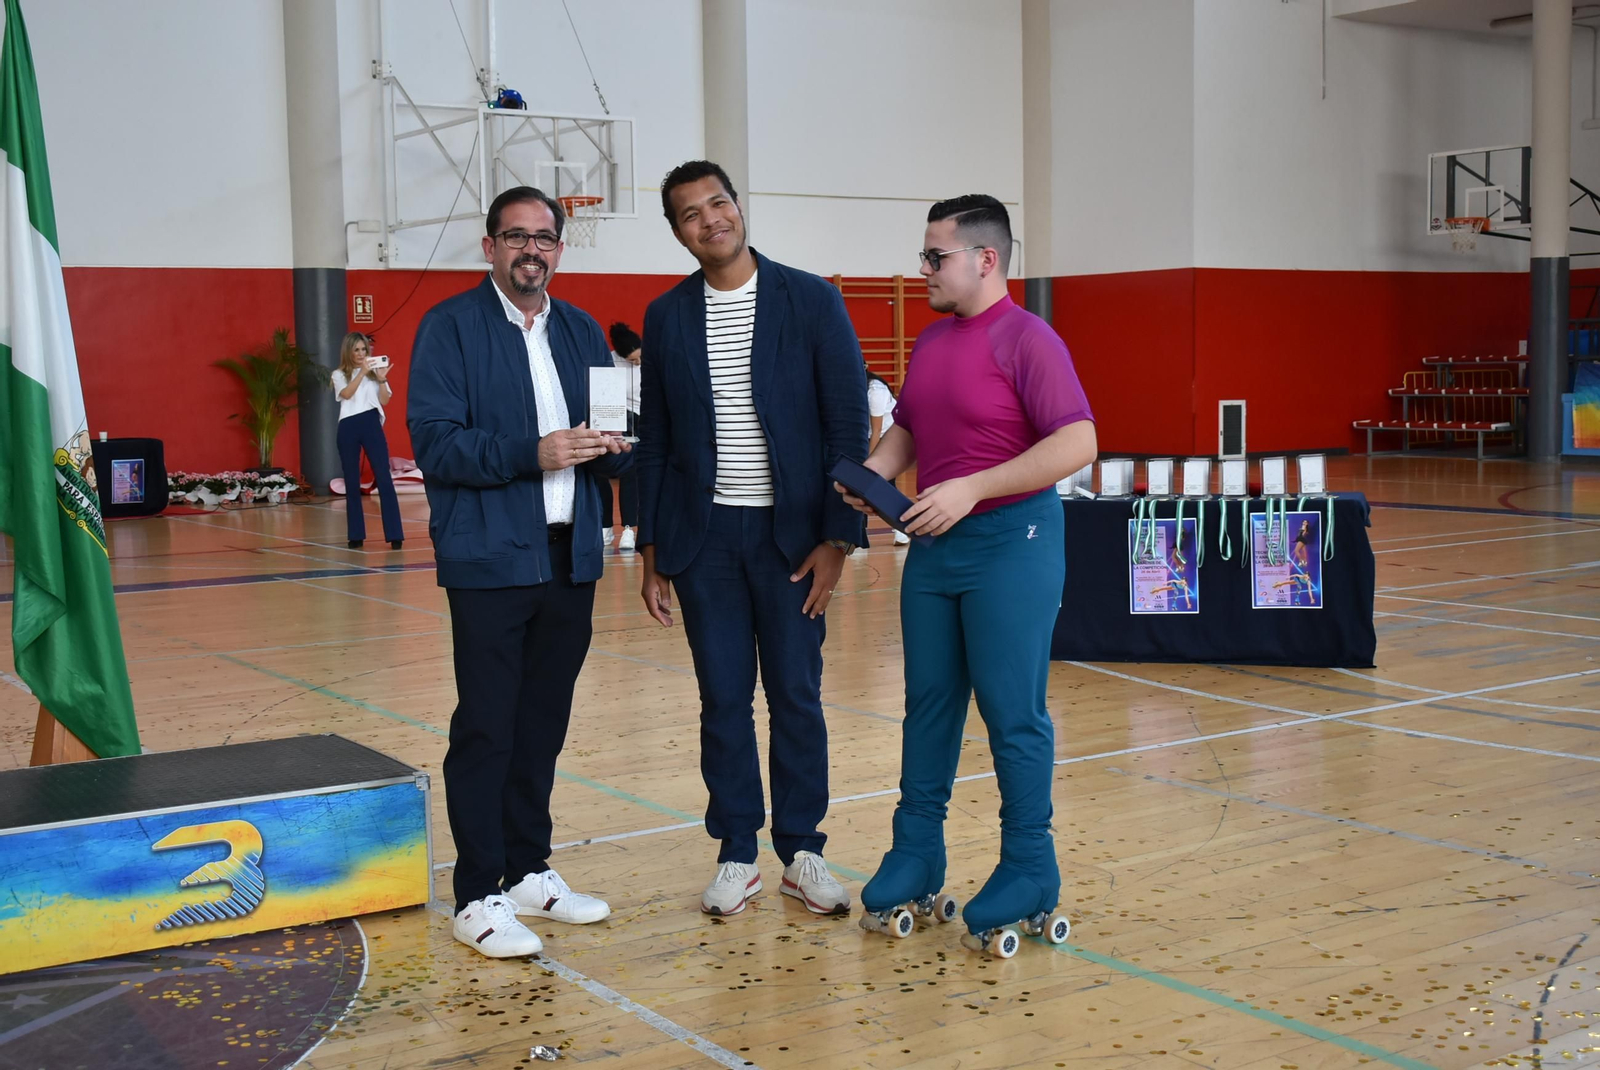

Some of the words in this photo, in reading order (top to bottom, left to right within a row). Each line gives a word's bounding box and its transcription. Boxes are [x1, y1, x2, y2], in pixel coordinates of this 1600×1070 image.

[60, 467, 99, 507] ANDALVCIA
[62, 481, 85, 504] PARA
[152, 819, 265, 932] 3
